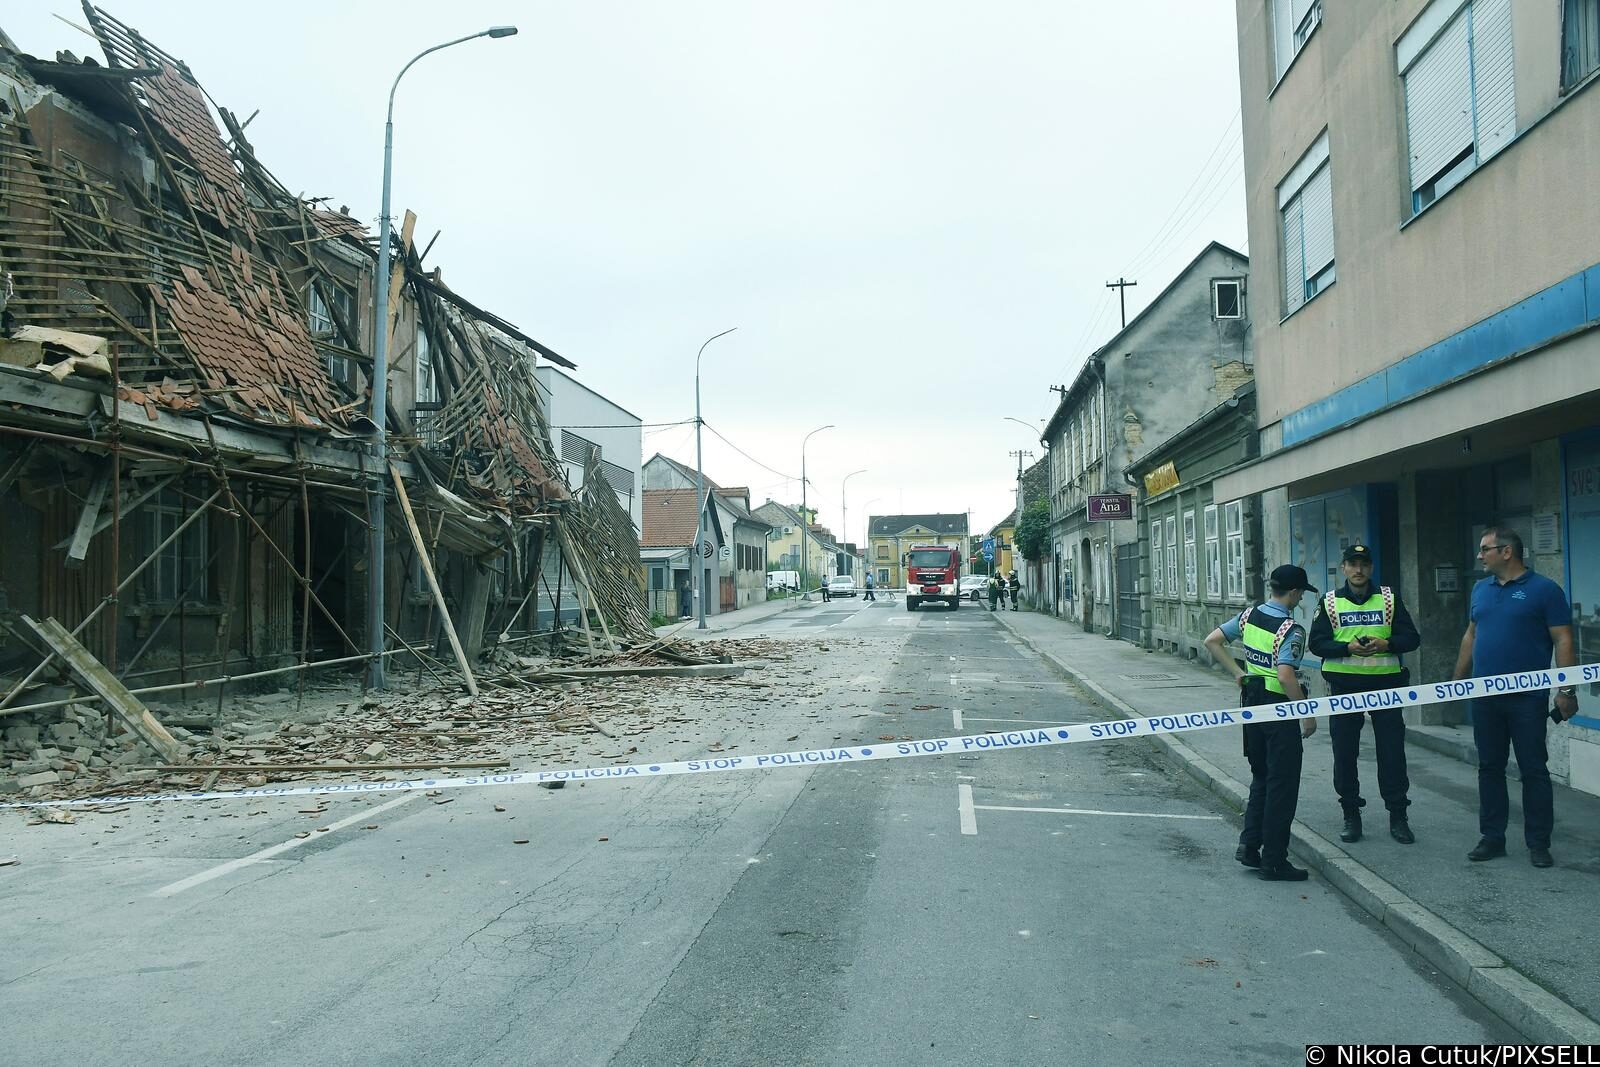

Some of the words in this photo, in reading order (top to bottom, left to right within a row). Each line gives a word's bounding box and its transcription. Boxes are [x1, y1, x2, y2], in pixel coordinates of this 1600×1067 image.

[1100, 503, 1120, 512] Ana
[1341, 613, 1382, 624] POLICIJA
[465, 774, 523, 785] STOP
[539, 766, 639, 780] POLICIJA
[687, 757, 742, 771] STOP
[758, 749, 852, 766] POLICIJA
[897, 740, 949, 755] STOP
[961, 729, 1052, 750] POLICIJA
[1089, 720, 1137, 738] STOP
[1148, 711, 1235, 732] POLICIJA
[1275, 701, 1319, 718] STOP
[1331, 689, 1403, 713] POLICIJA
[1435, 681, 1475, 700] STOP
[1484, 672, 1551, 694] POLICIJA
